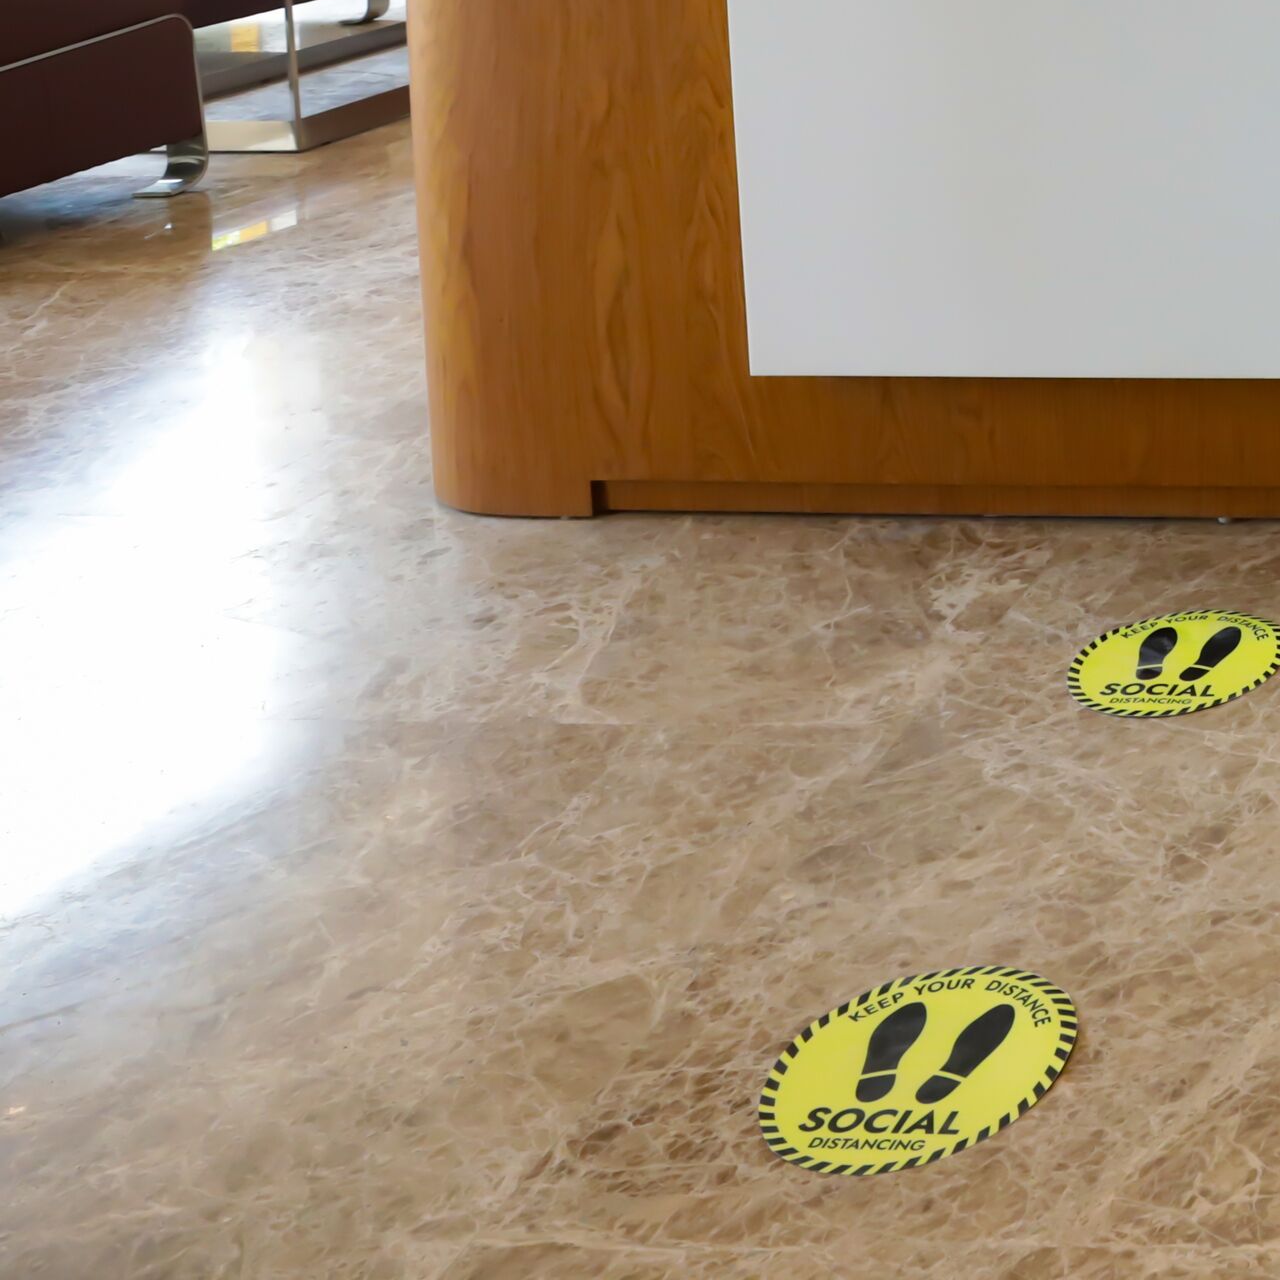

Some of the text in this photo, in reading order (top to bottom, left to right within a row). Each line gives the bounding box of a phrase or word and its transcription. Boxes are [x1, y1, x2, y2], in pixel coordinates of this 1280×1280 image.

[1121, 614, 1269, 641] KEEP YOUR DISTANCE
[1100, 682, 1217, 698] SOCIAL
[1108, 697, 1192, 705] DISTANCING
[848, 978, 1052, 1028] KEEP YOUR DISTANCE
[797, 1106, 960, 1135] SOCIAL
[807, 1137, 926, 1151] DISTANCING
